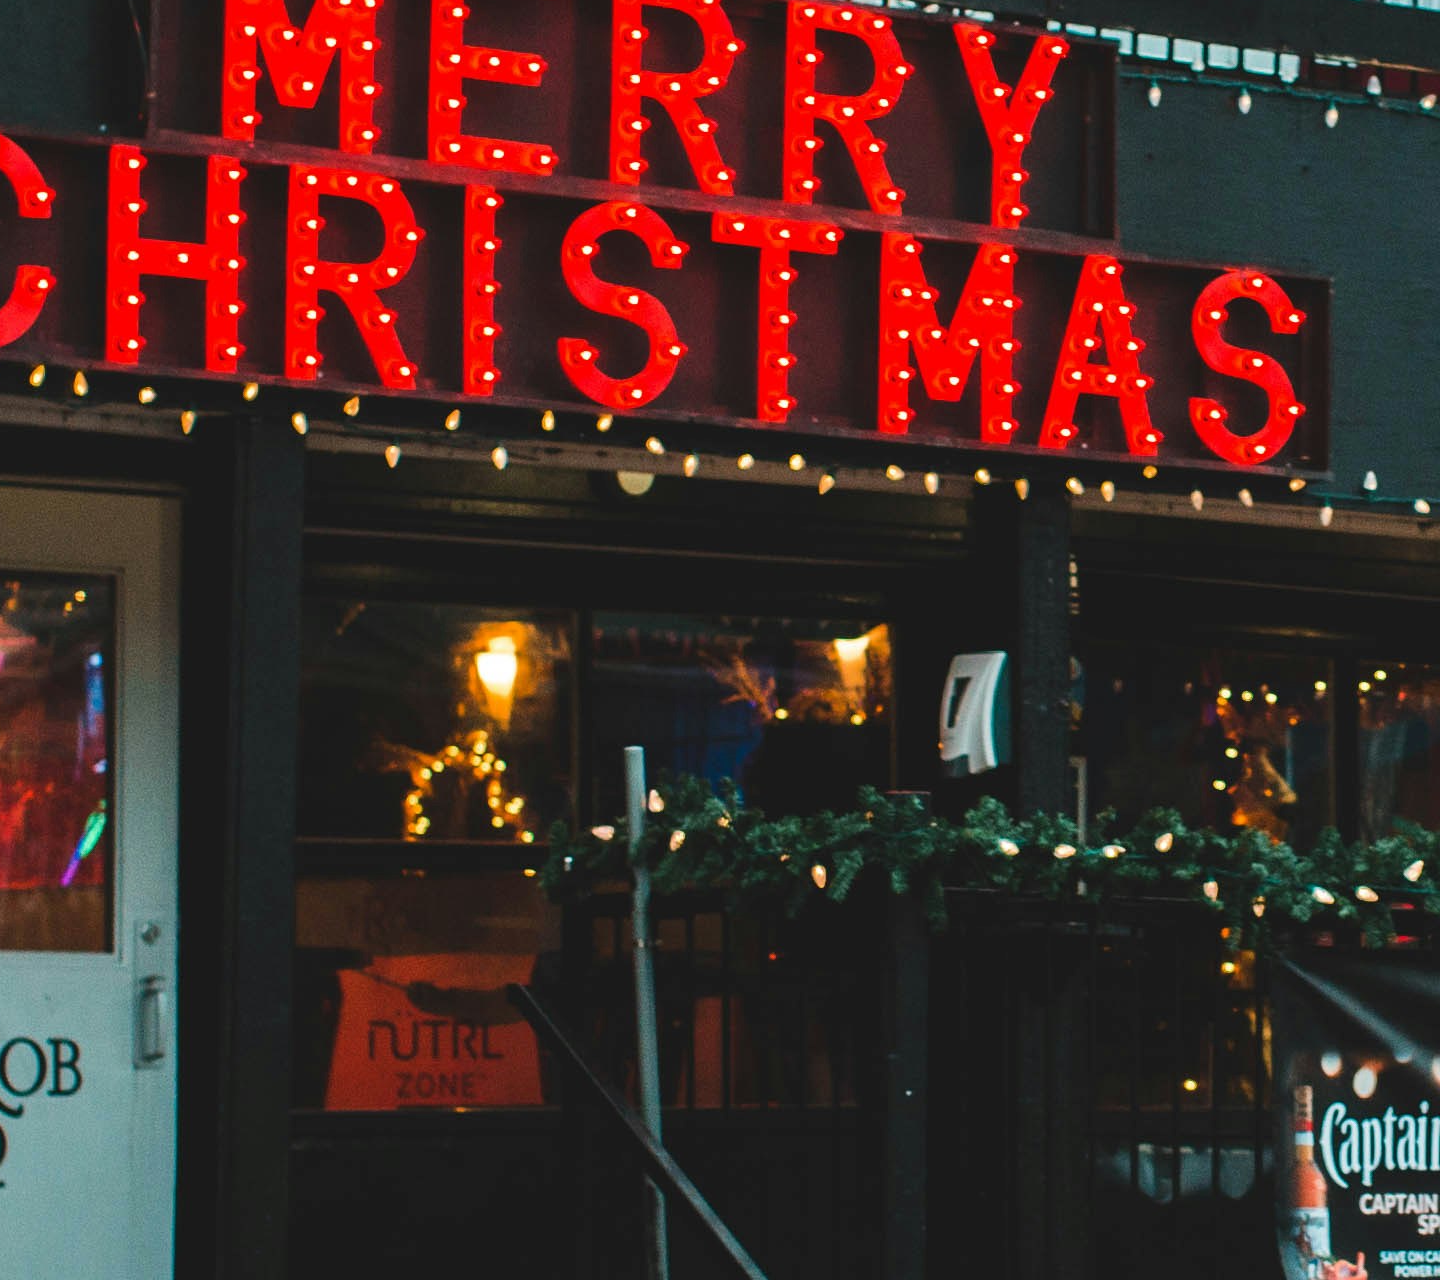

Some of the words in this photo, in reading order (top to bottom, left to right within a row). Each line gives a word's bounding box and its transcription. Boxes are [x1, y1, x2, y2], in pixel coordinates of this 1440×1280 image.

[396, 1073, 477, 1099] ZONE
[1359, 1193, 1439, 1215] CAPTAIN
[1379, 1250, 1407, 1263] SAVE
[1408, 1250, 1425, 1263] ON
[1394, 1265, 1433, 1277] POWER
